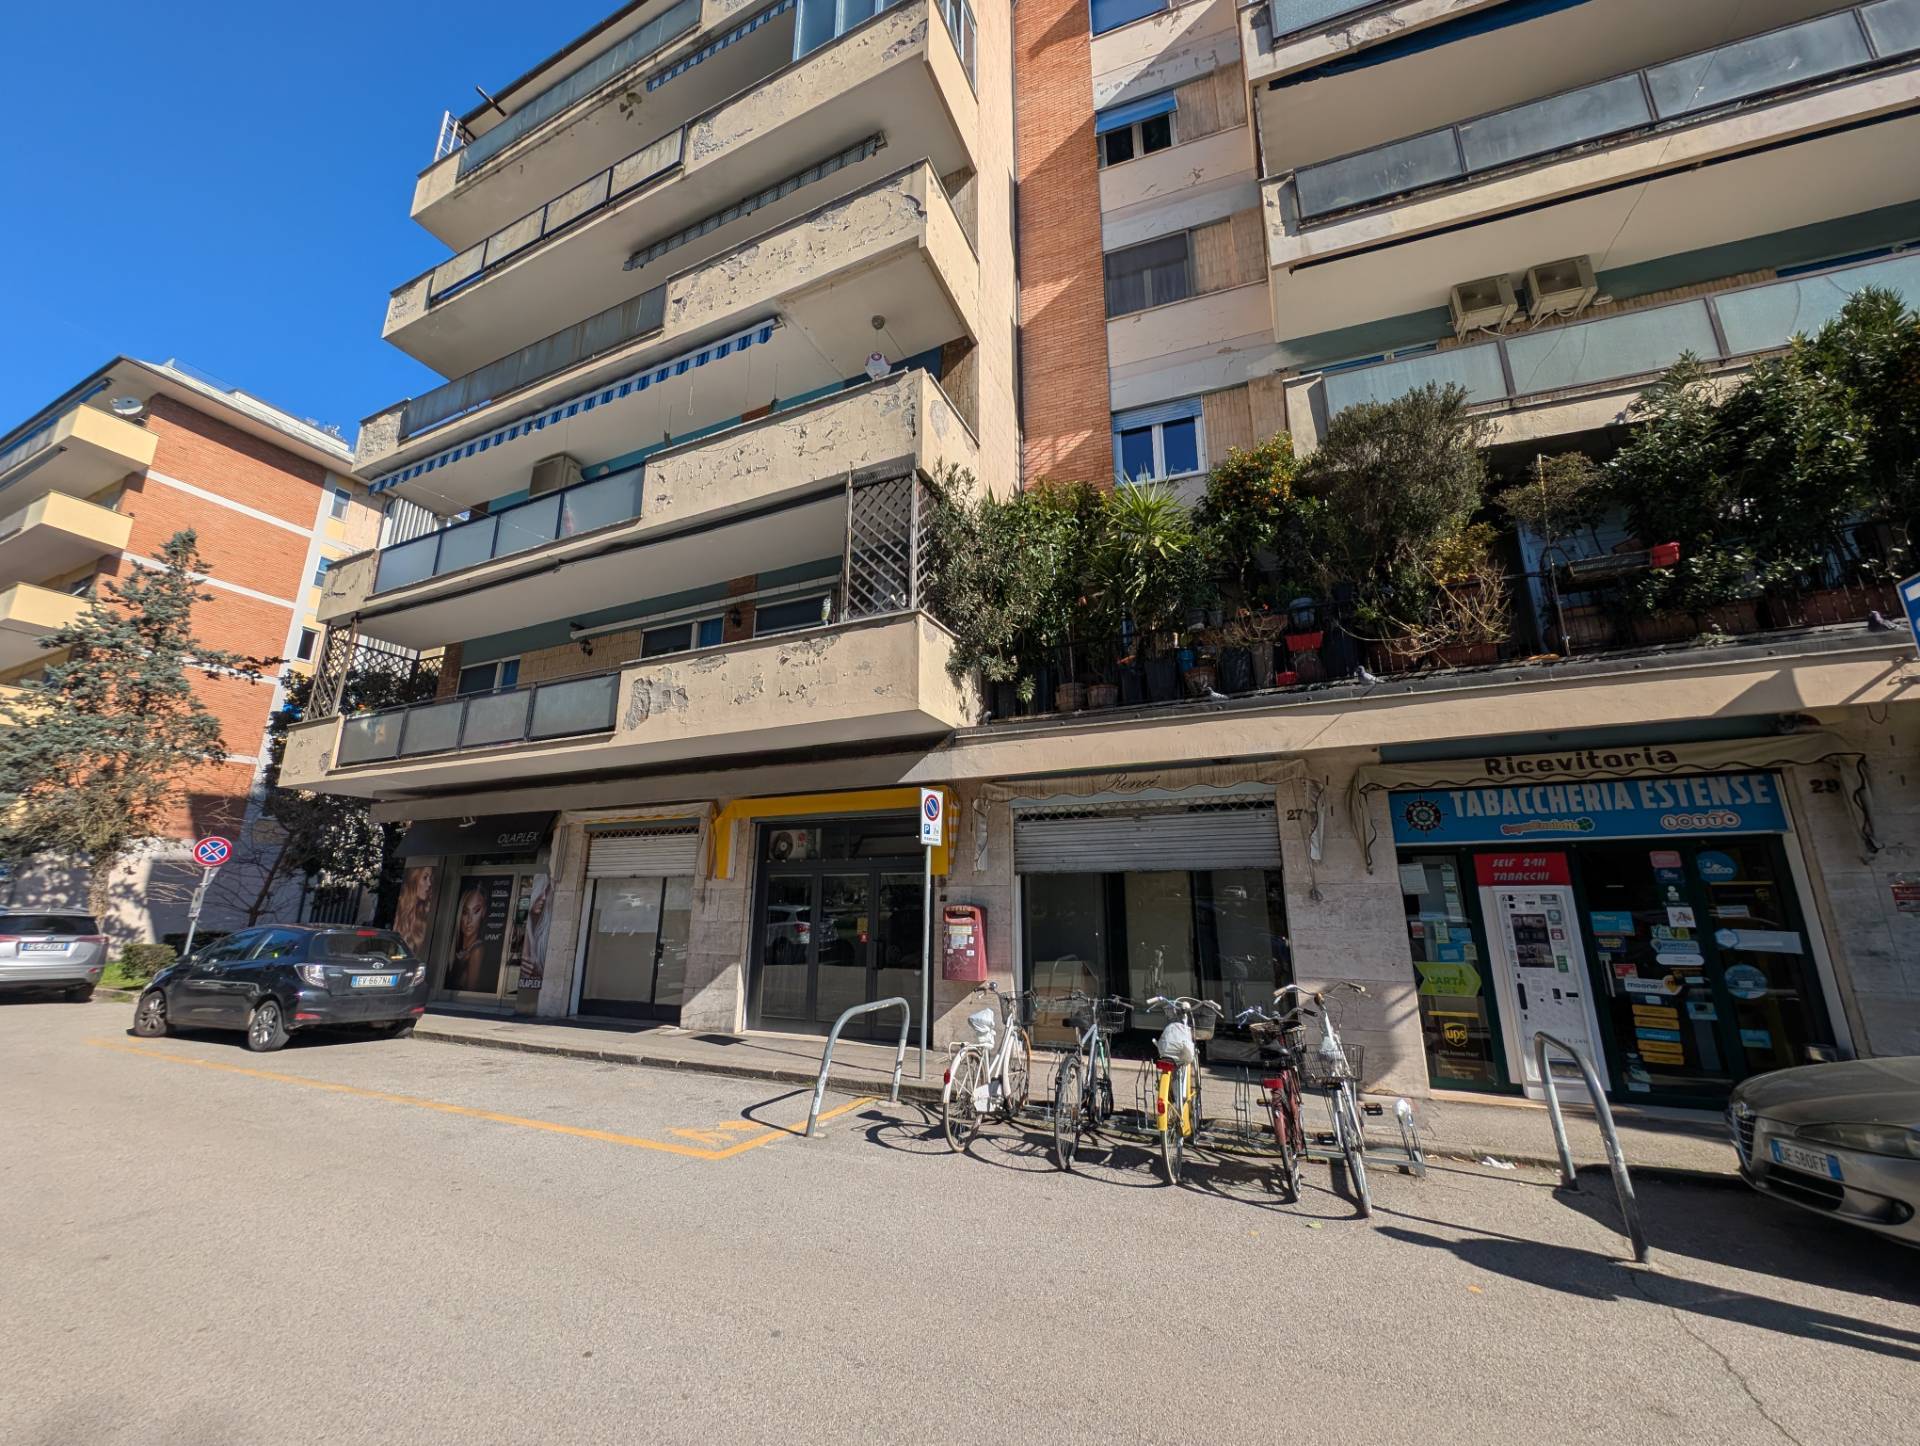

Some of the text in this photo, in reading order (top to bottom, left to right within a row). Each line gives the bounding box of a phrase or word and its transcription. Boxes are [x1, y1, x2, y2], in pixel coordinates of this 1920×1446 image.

[1485, 747, 1678, 776] Ricevitoria
[1809, 778, 1840, 794] 29
[1451, 781, 1635, 818] TABACCHERIA
[1638, 773, 1771, 810] ESTENSE
[1287, 808, 1303, 821] 27
[497, 831, 540, 845] OLAPLEX
[1493, 871, 1550, 881] TABACCHI
[519, 978, 541, 989] OLAPLEX
[1447, 1030, 1466, 1043] ups
